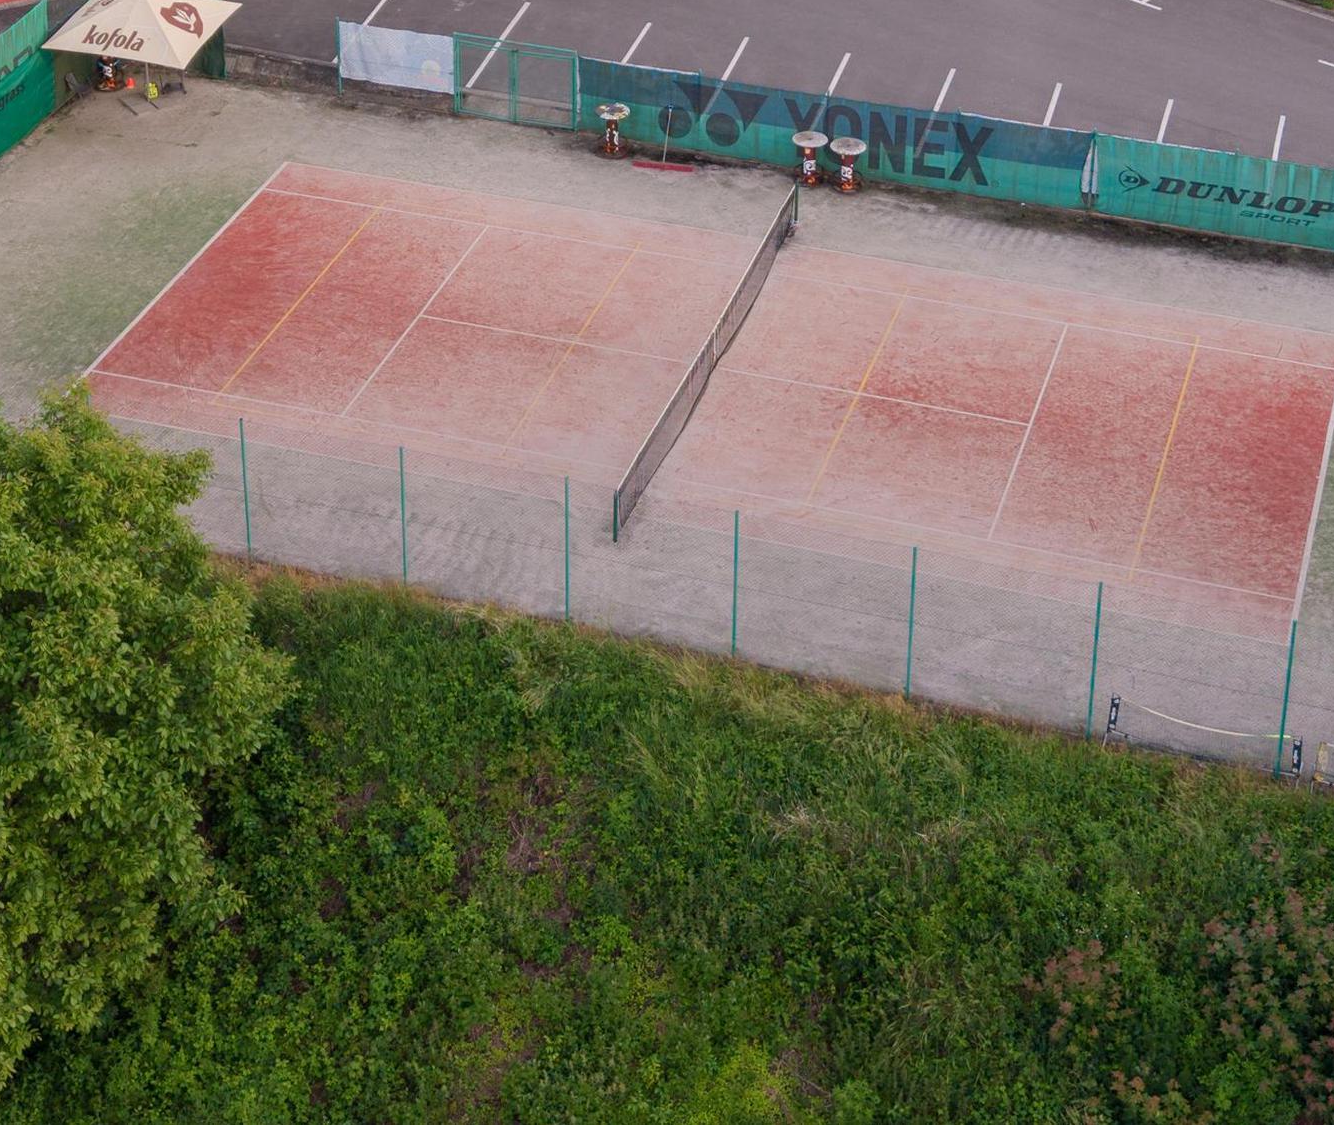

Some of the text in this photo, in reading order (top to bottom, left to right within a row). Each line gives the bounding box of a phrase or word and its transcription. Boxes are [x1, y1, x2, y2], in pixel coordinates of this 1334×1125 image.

[82, 24, 145, 51] kofola
[784, 98, 994, 186] YONEX
[1240, 210, 1316, 227] SPORT
